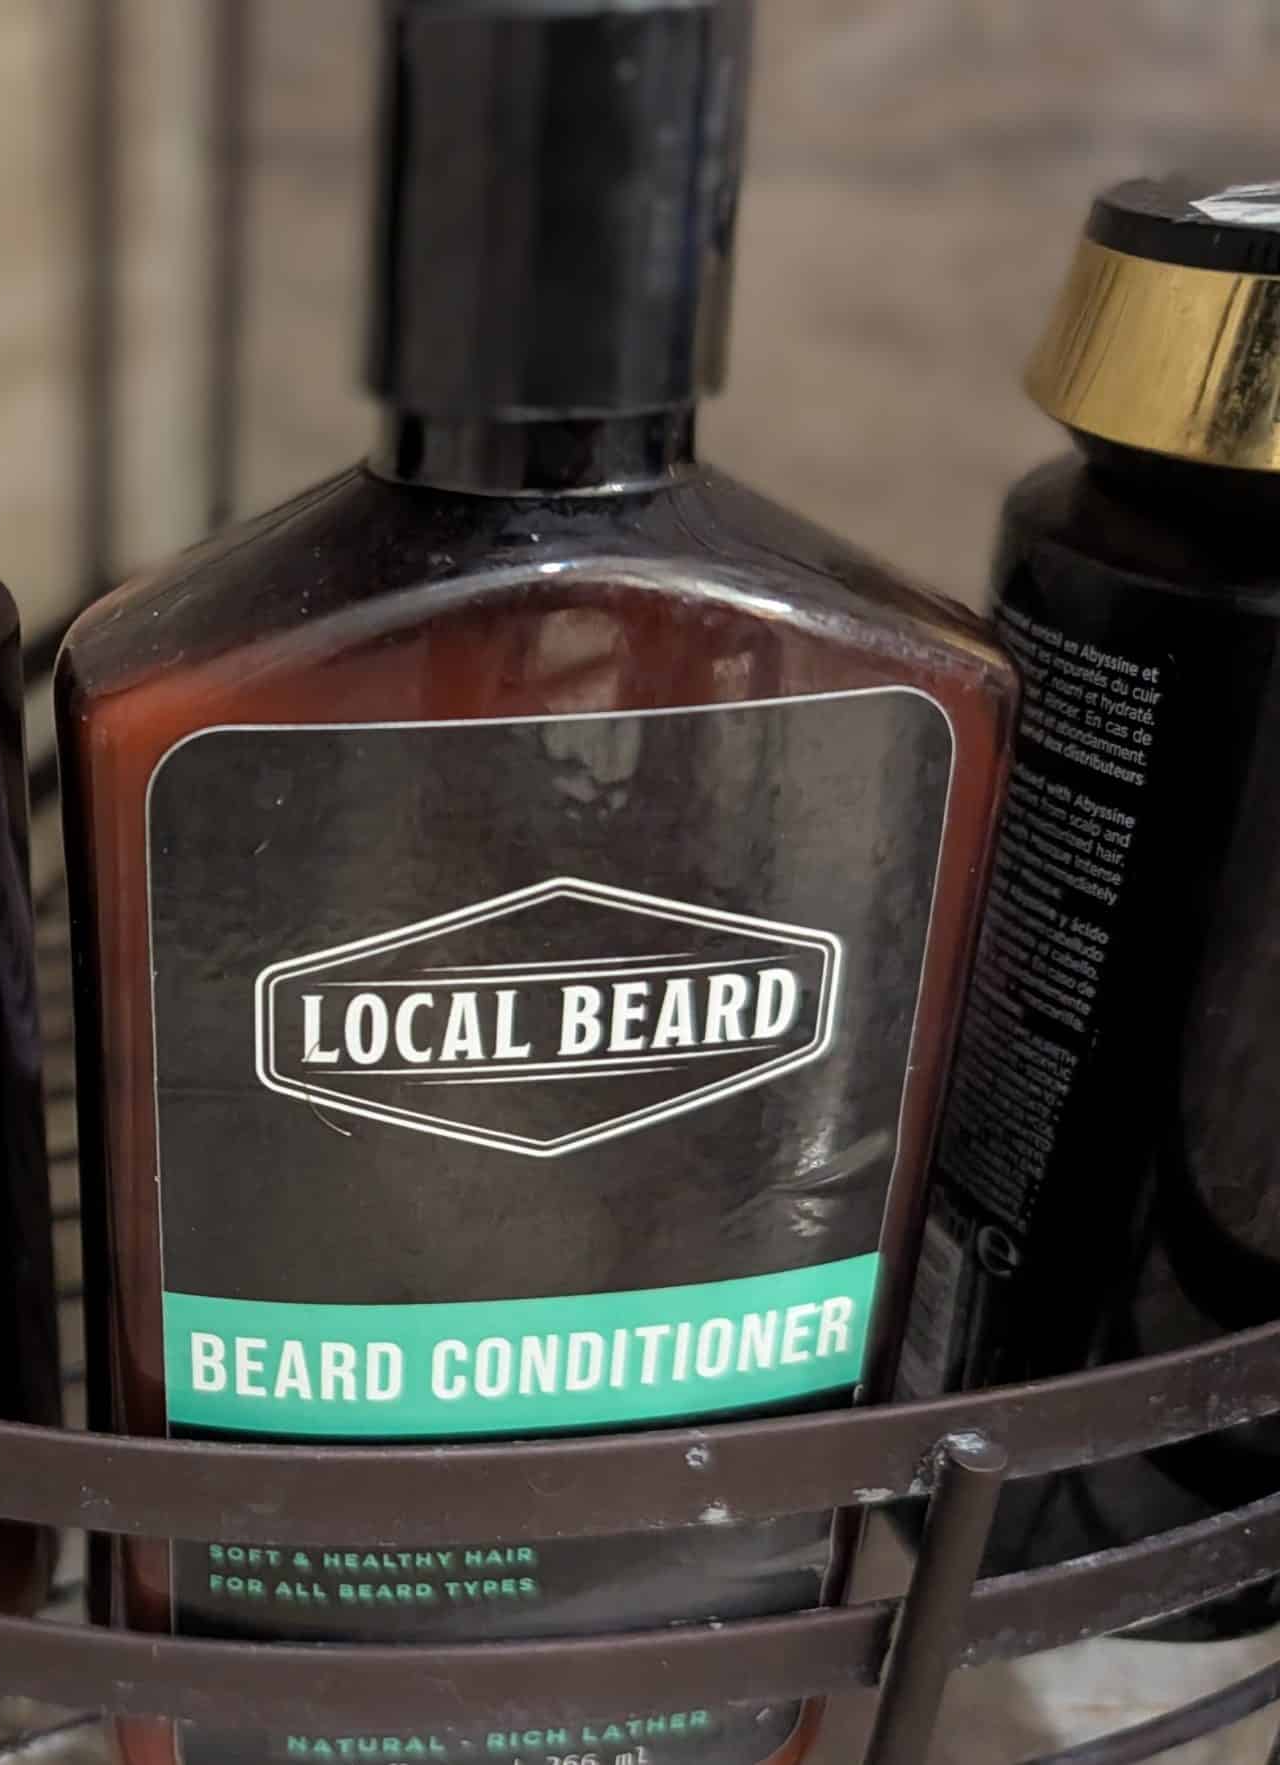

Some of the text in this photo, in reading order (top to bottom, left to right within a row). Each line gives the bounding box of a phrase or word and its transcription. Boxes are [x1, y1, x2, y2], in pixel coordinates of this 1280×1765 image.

[1080, 644, 1139, 678] Abyssine
[1141, 666, 1160, 684] et
[1111, 674, 1129, 696] du
[1132, 684, 1161, 706] cuir
[1100, 693, 1156, 726] hydraté.
[1084, 710, 1103, 730] En
[1104, 719, 1129, 739] cas
[1132, 724, 1153, 746] de
[1063, 742, 1145, 786] distributeurs
[1073, 794, 1135, 830] Abyssine
[1103, 826, 1131, 849] and
[1095, 842, 1125, 868] hair.
[301, 967, 798, 1066] LOCAL BEARD
[190, 1295, 855, 1402] BEARD CONDITIONER
[209, 1543, 534, 1569] SOFT & HEALTHY HAIR
[209, 1573, 536, 1600] FOR ALL BEARD TYPES
[287, 1733, 446, 1756] NATURAL
[486, 1727, 569, 1749] RICH
[581, 1709, 711, 1744] LATHER
[615, 1746, 649, 1765] ml
